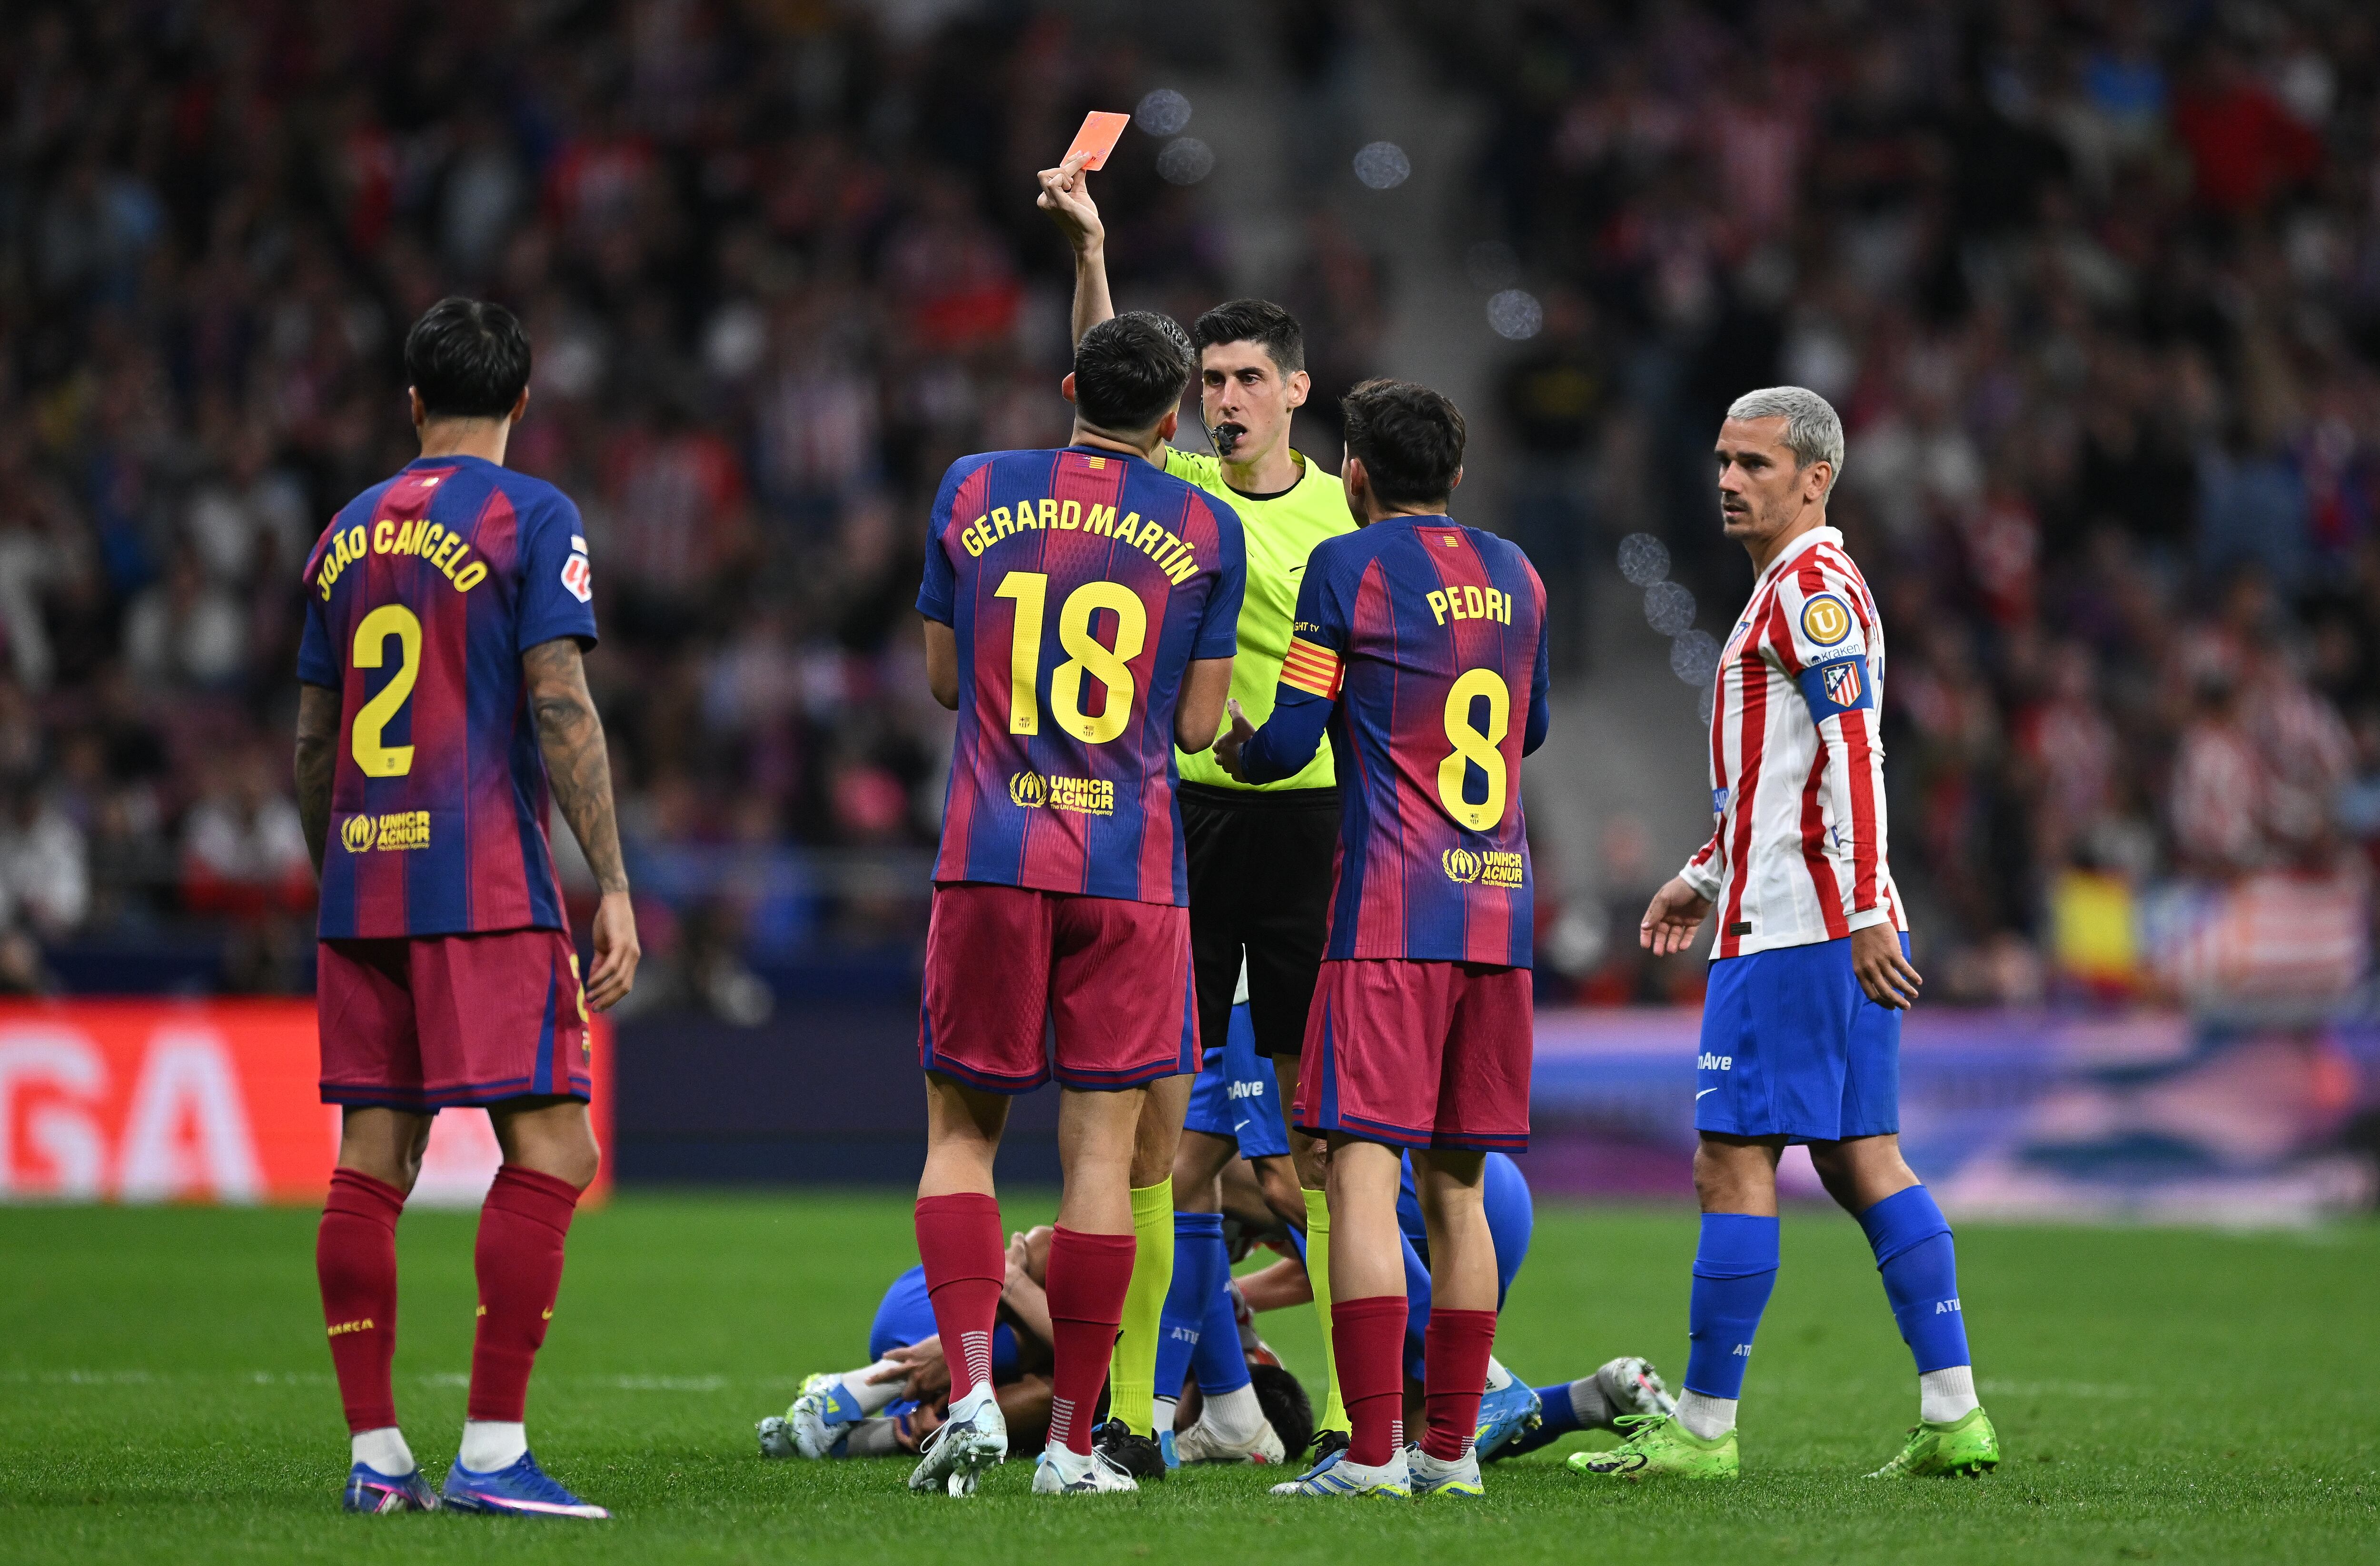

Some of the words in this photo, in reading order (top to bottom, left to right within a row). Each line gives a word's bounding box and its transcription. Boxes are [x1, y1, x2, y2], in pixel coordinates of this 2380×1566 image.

[962, 499, 1081, 557] GERARD
[1083, 503, 1199, 586] MARTÍN
[317, 526, 367, 601] JOÃO
[374, 520, 487, 592] CANCELO
[1426, 586, 1511, 626] PEDRI
[1293, 622, 1309, 632] GHT
[1310, 623, 1319, 632] tv
[1812, 608, 1837, 633] U
[994, 571, 1147, 744] 18
[352, 604, 422, 778] 2
[1438, 668, 1510, 831] 8
[1050, 775, 1114, 795] UNHCR
[1050, 789, 1114, 809] ACNUR
[379, 811, 430, 830] UNHCR
[377, 827, 430, 844] ACNUR
[1482, 851, 1522, 868] UNHCR
[1481, 865, 1523, 882] ACNUR
